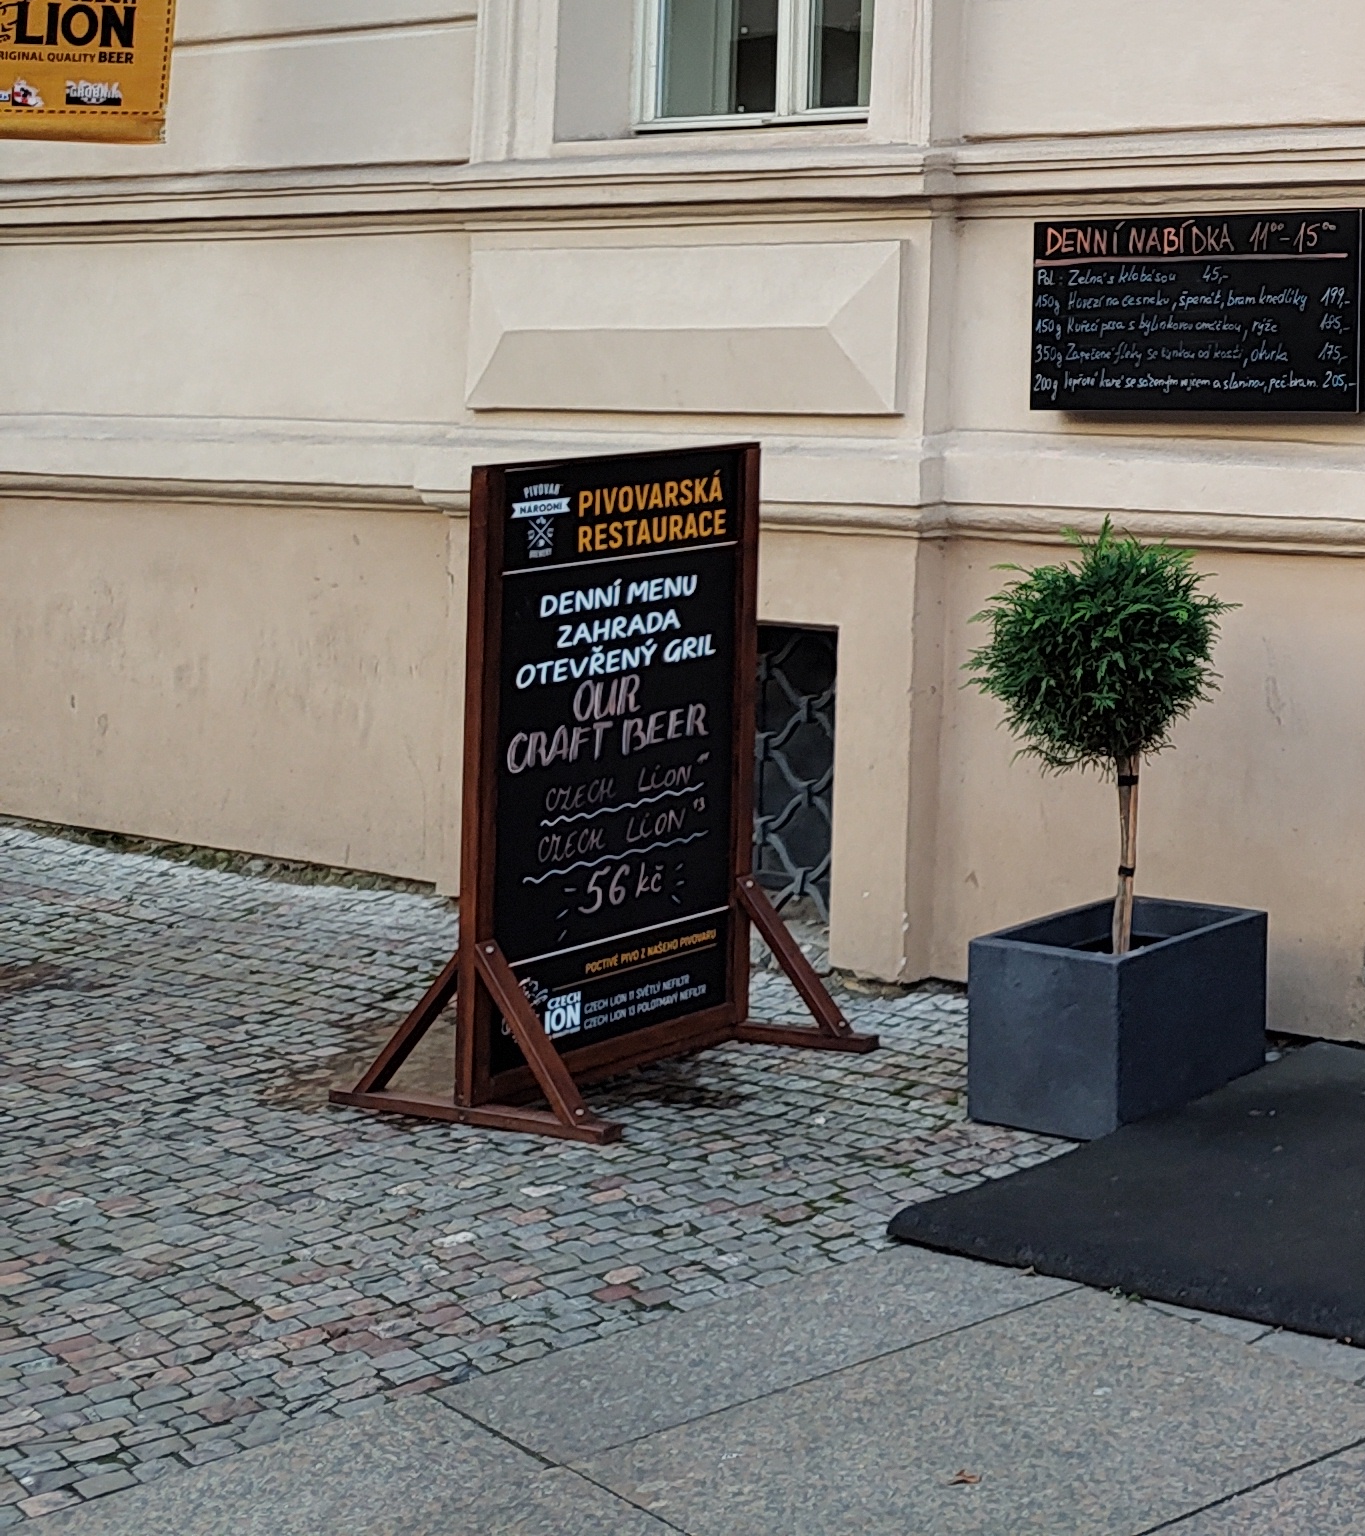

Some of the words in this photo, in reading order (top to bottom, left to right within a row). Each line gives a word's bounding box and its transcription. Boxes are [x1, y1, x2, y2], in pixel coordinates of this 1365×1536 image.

[13, 0, 137, 49] LION
[0, 50, 44, 62] RIGINAL
[47, 52, 96, 63] QUALITY
[98, 51, 134, 64] BEER
[1045, 221, 1126, 256] DENNÍ
[1128, 219, 1235, 255] NABÍDKA
[578, 469, 723, 518] PIVOVARSKÁ
[577, 509, 727, 553] RESTAURACE
[540, 578, 622, 618] DENNÍ
[626, 574, 698, 605] MENU
[557, 609, 681, 649] ZAHRADA
[515, 638, 658, 690] OTEVŘENÝ
[662, 634, 716, 663] GRIL
[573, 674, 641, 722] OUR
[507, 720, 613, 774] CRAFT
[622, 703, 709, 756] BEER
[620, 949, 640, 965] PIVO
[544, 1002, 582, 1035] ION
[547, 990, 582, 1011] CZECH
